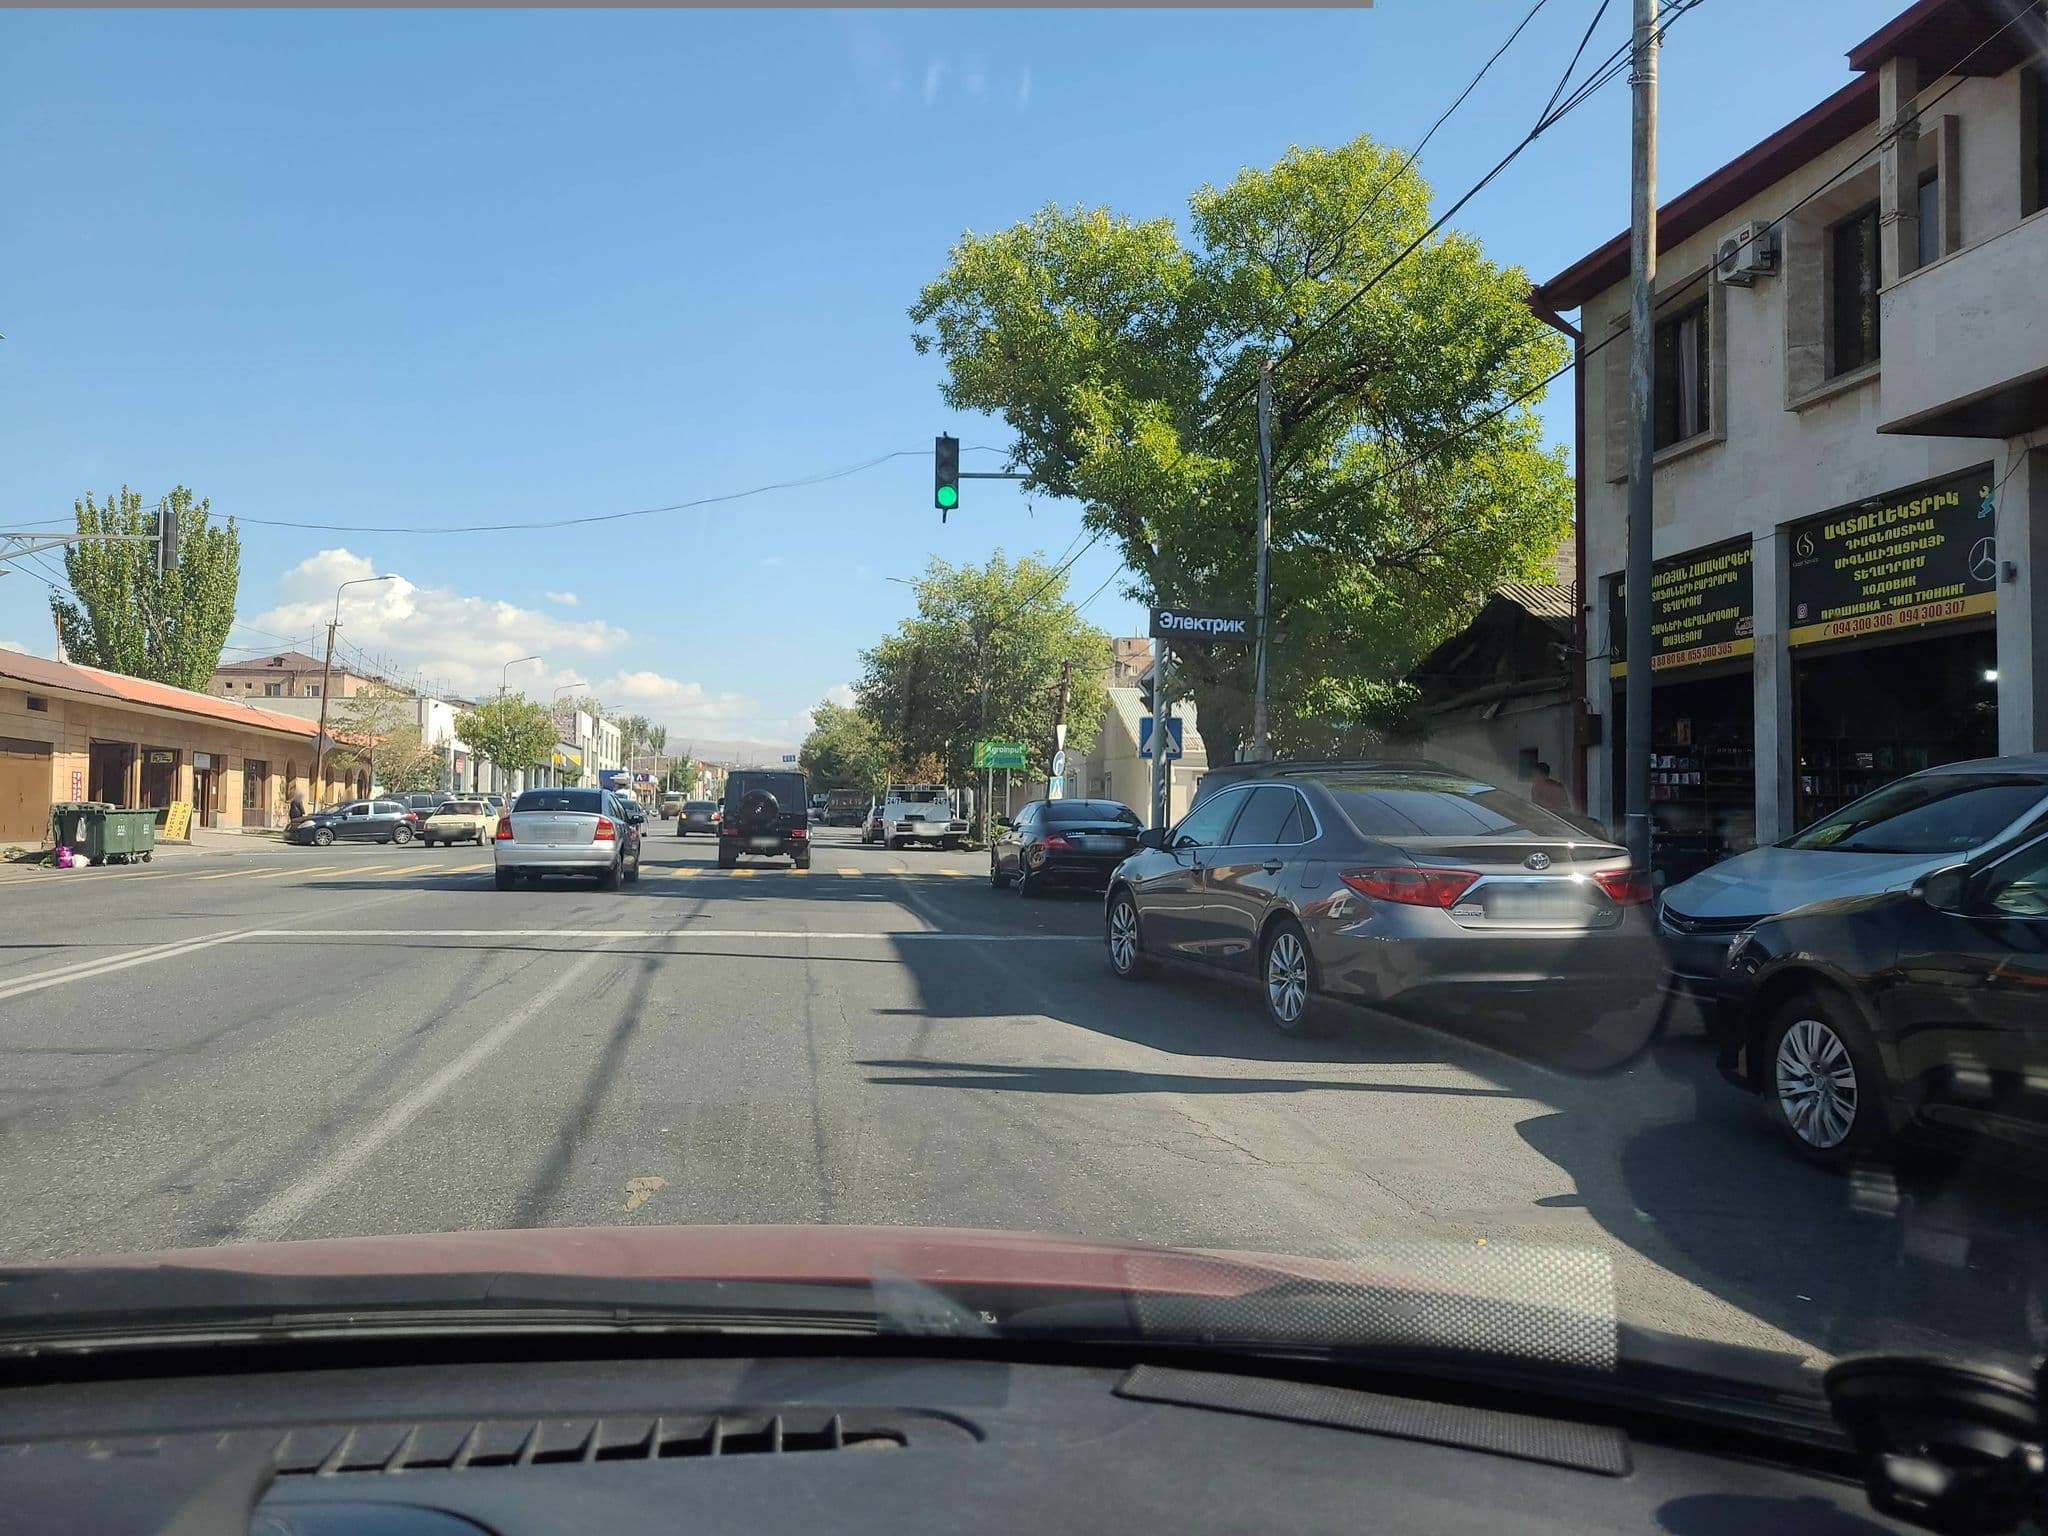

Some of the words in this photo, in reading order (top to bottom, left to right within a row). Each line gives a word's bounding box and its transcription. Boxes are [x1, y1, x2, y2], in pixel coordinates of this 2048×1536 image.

[1889, 592, 1915, 607] ЧИП
[1915, 582, 1966, 603] ТЮНИНГ
[1159, 611, 1246, 635] Электрик
[1832, 620, 1851, 636] 094
[1852, 617, 1871, 632] 300
[1899, 609, 1919, 624] 094
[1921, 604, 1943, 621] 300
[1945, 600, 1966, 616] 307
